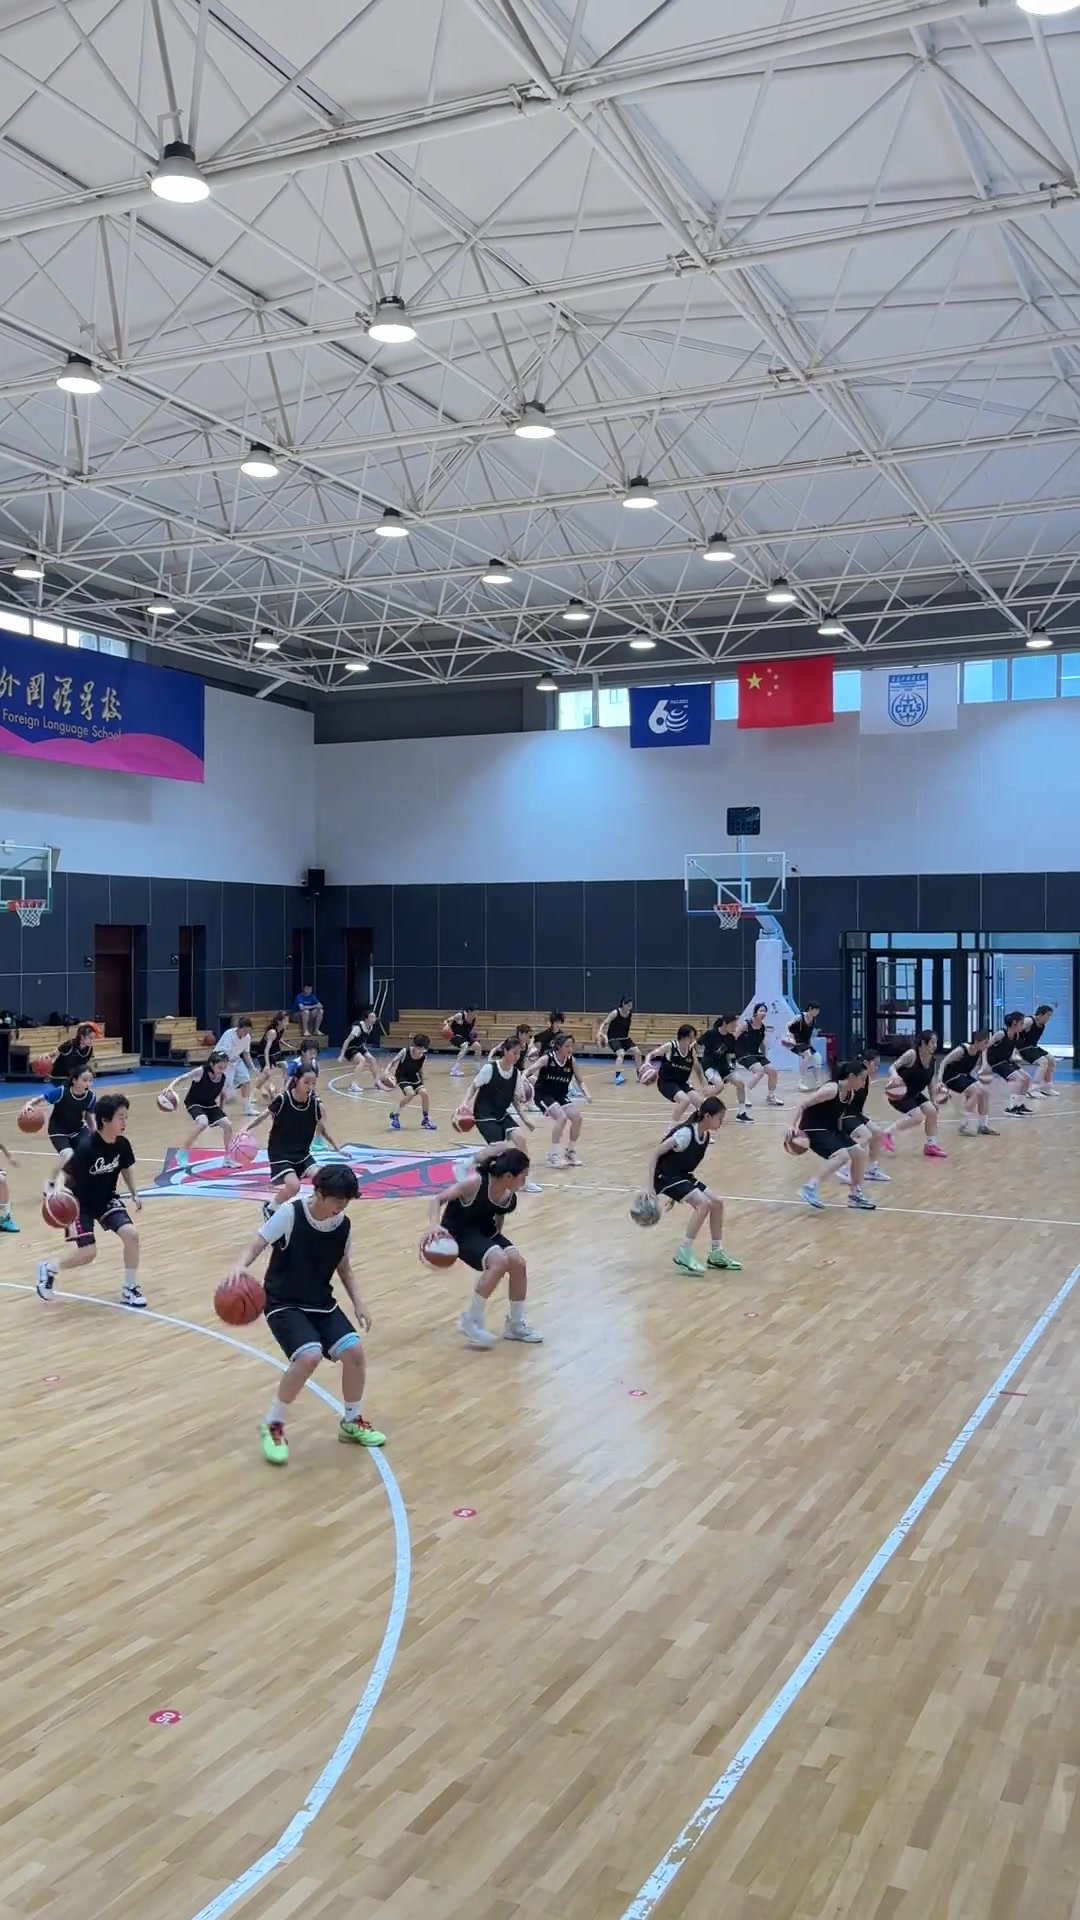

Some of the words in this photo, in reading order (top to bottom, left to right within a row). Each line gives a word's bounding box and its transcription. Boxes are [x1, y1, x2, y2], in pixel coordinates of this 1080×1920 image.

[895, 703, 922, 713] CFLS
[2, 708, 40, 729] Foreign
[43, 715, 89, 738] Language
[92, 725, 122, 741] School
